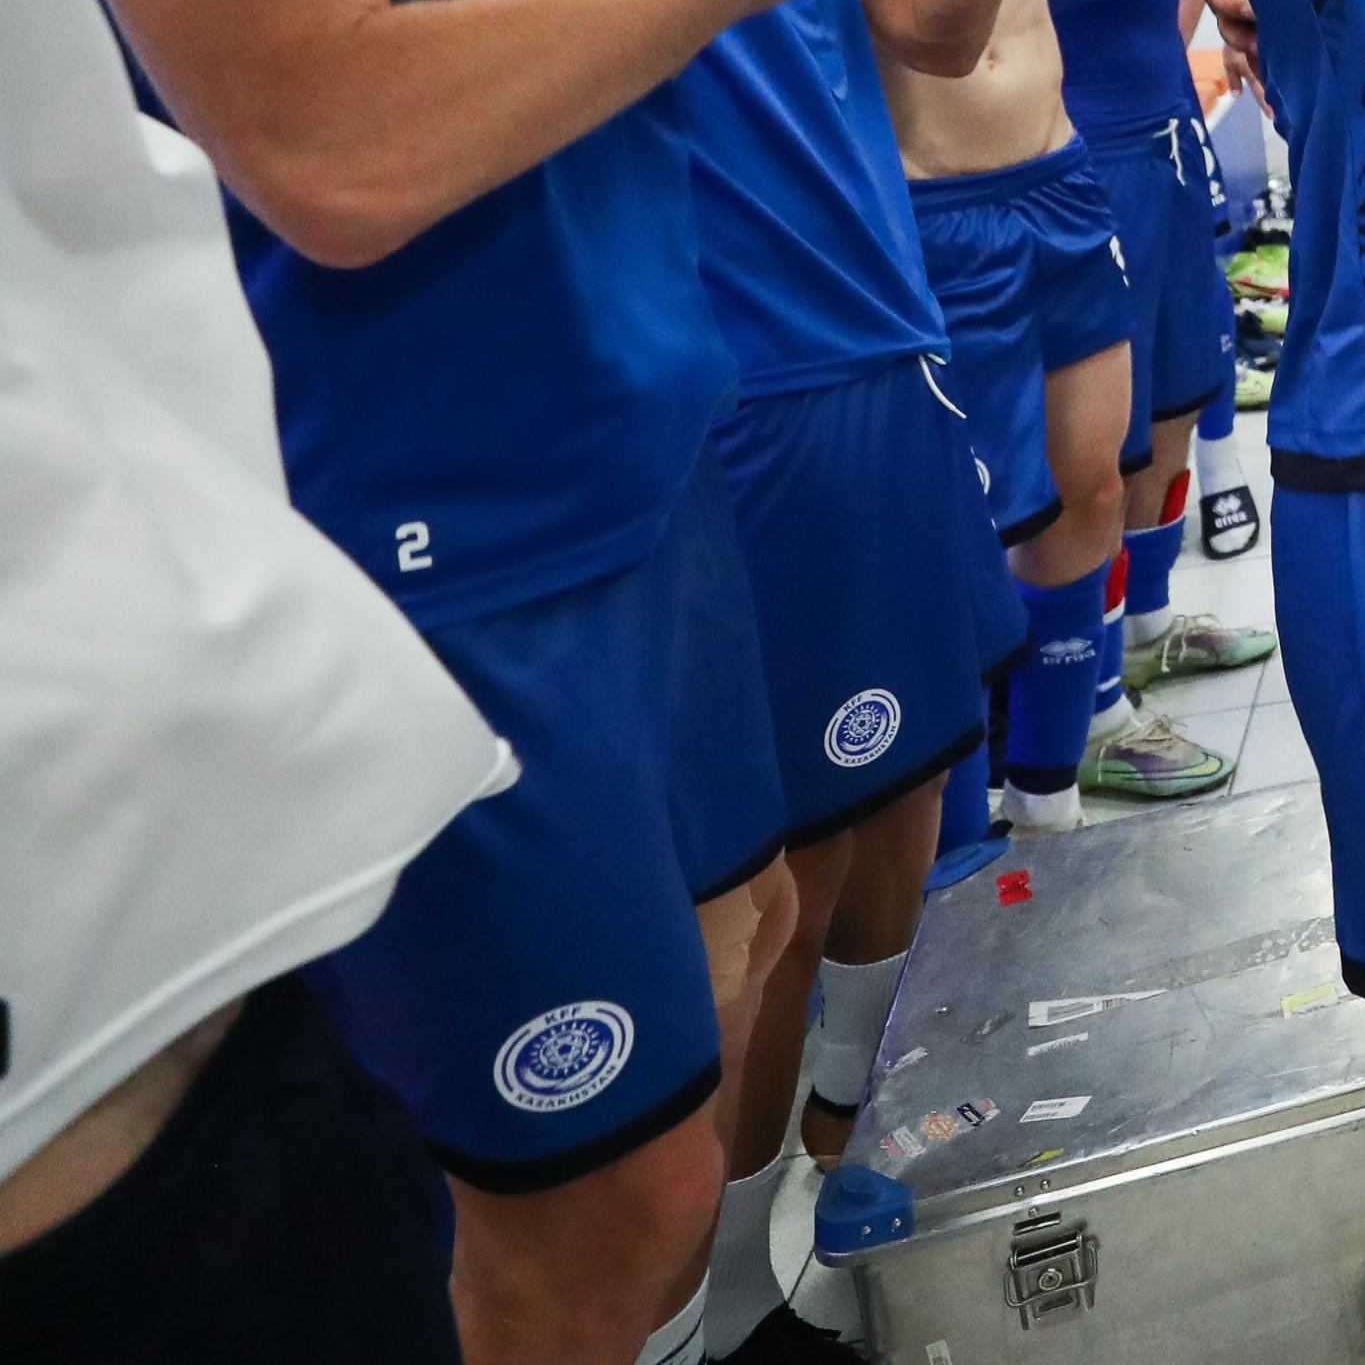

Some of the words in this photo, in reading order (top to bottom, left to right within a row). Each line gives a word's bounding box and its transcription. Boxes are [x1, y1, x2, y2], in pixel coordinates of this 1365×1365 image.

[395, 521, 432, 573] 2
[843, 695, 863, 712] KFF
[544, 1006, 582, 1026] KFF
[515, 1064, 617, 1108] KAZAKHSTAN
